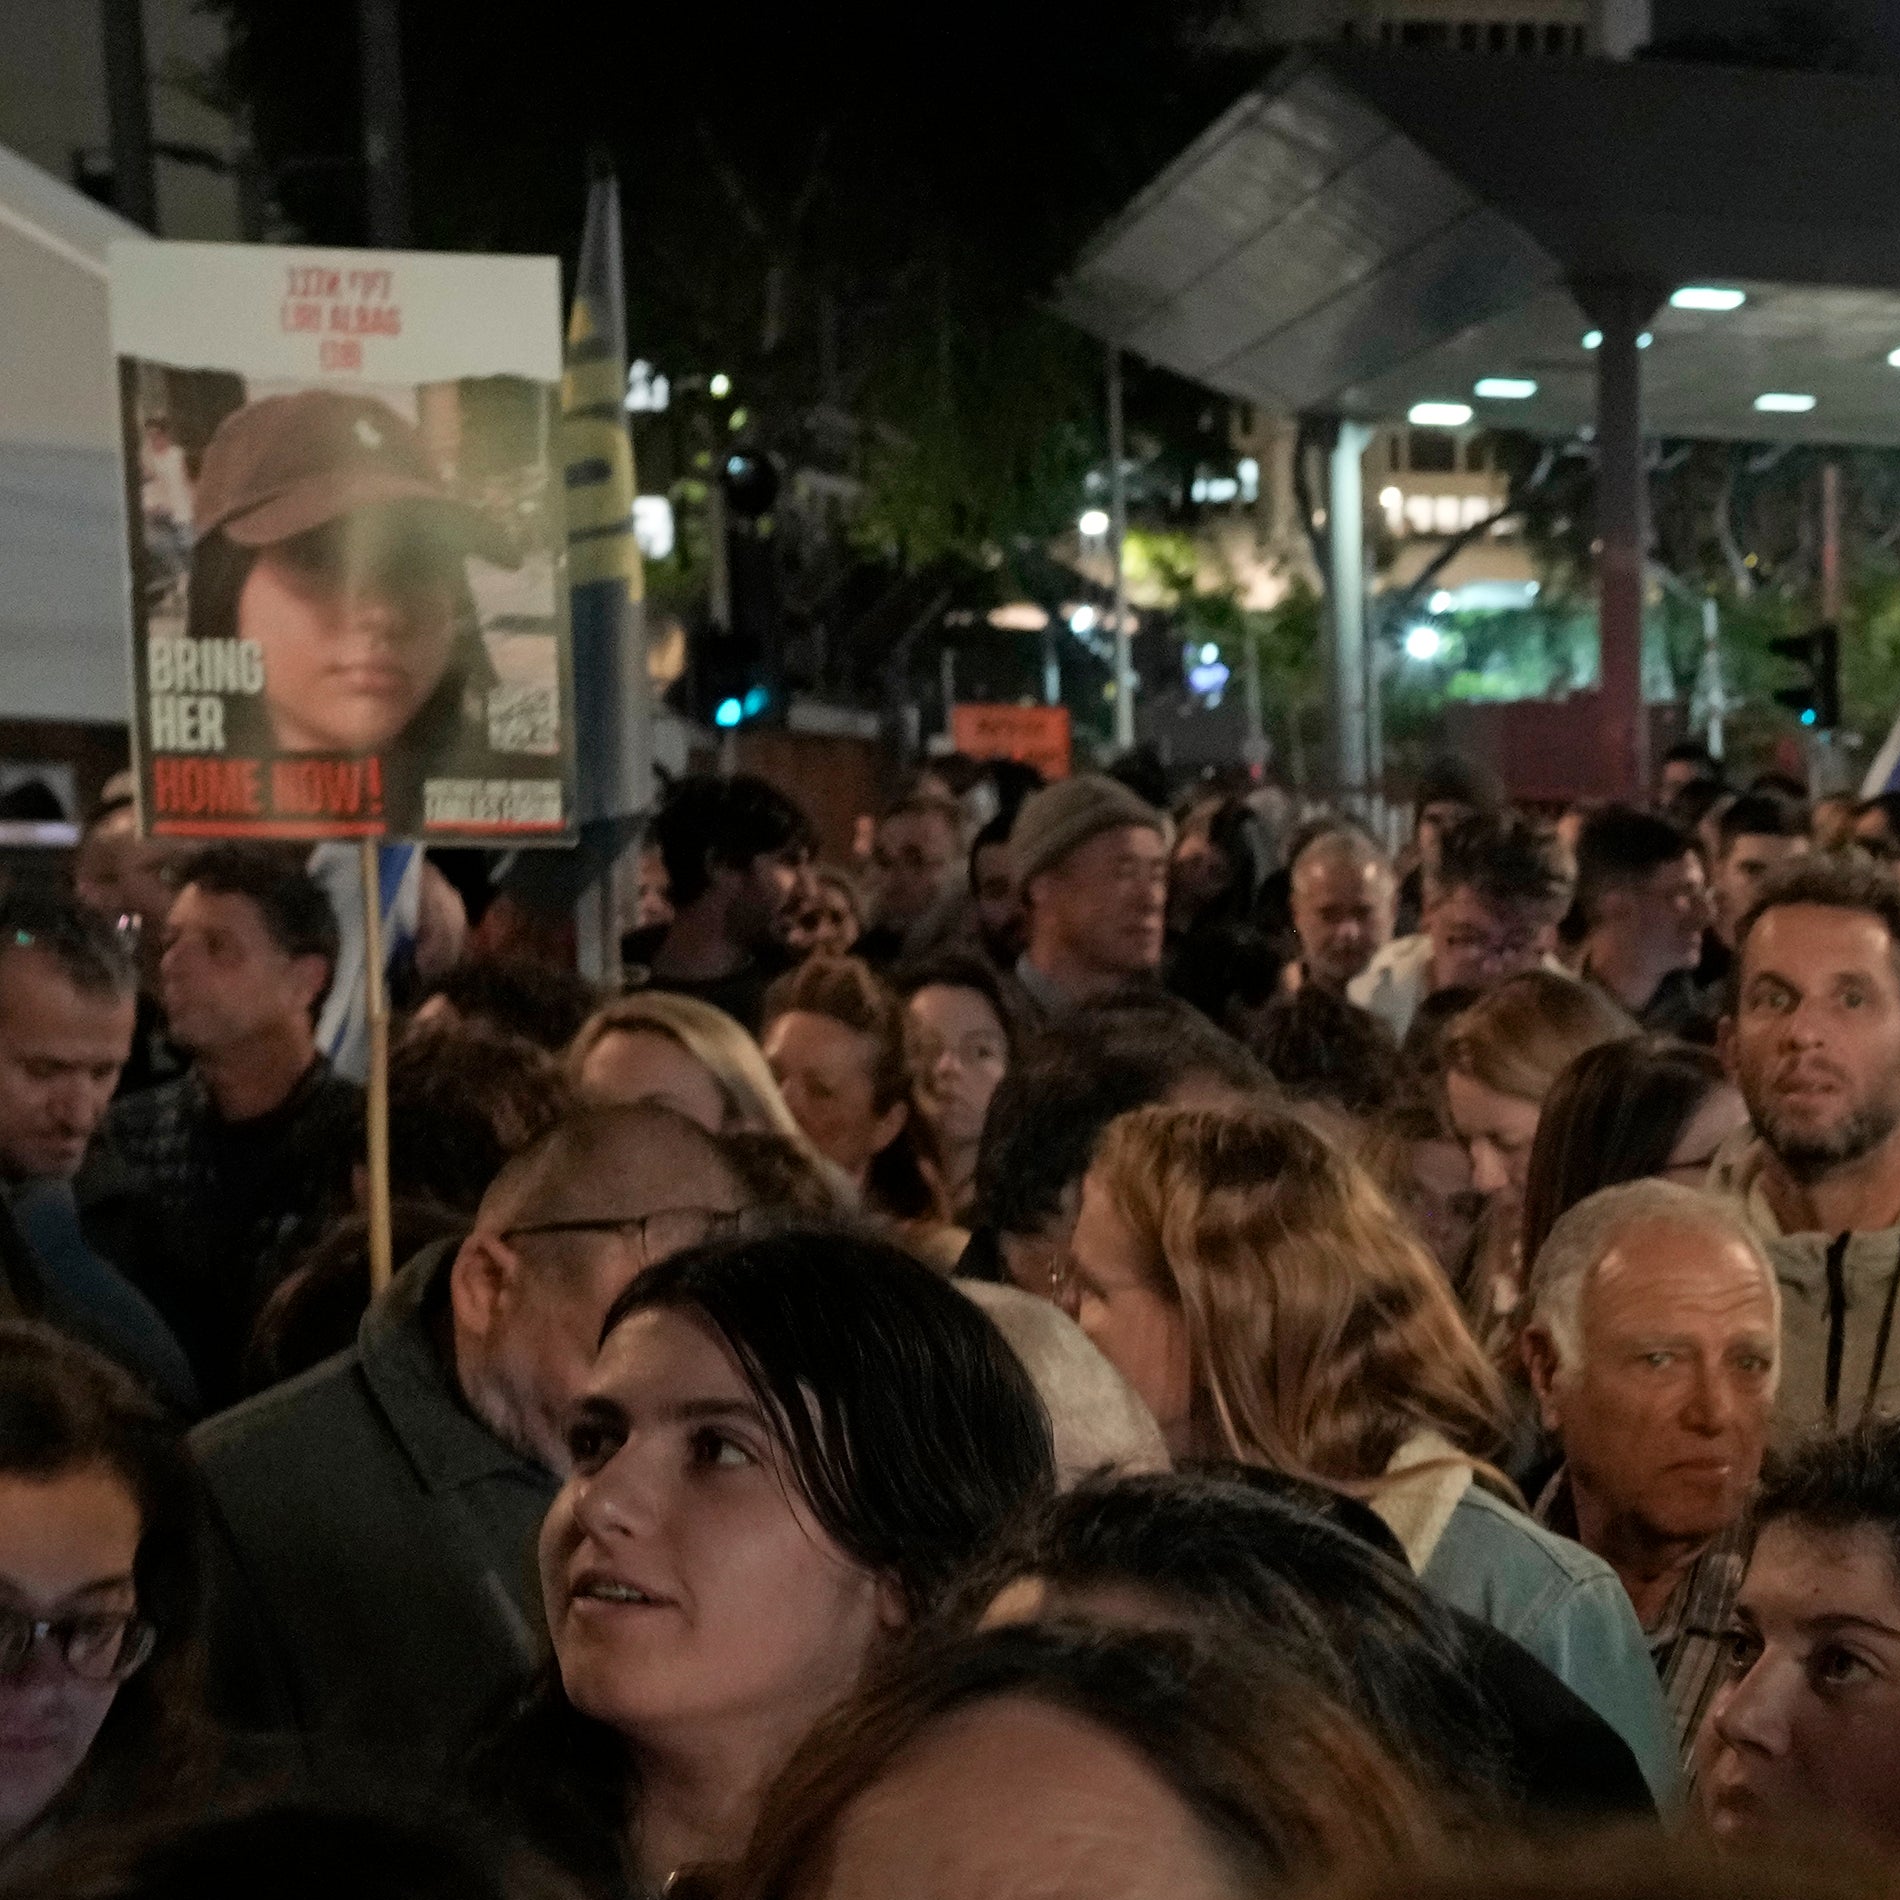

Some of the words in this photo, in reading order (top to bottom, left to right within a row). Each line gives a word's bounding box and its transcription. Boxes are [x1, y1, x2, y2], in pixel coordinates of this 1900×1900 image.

[149, 638, 265, 693] BRING
[151, 696, 227, 750] HER
[154, 757, 262, 812] HOME
